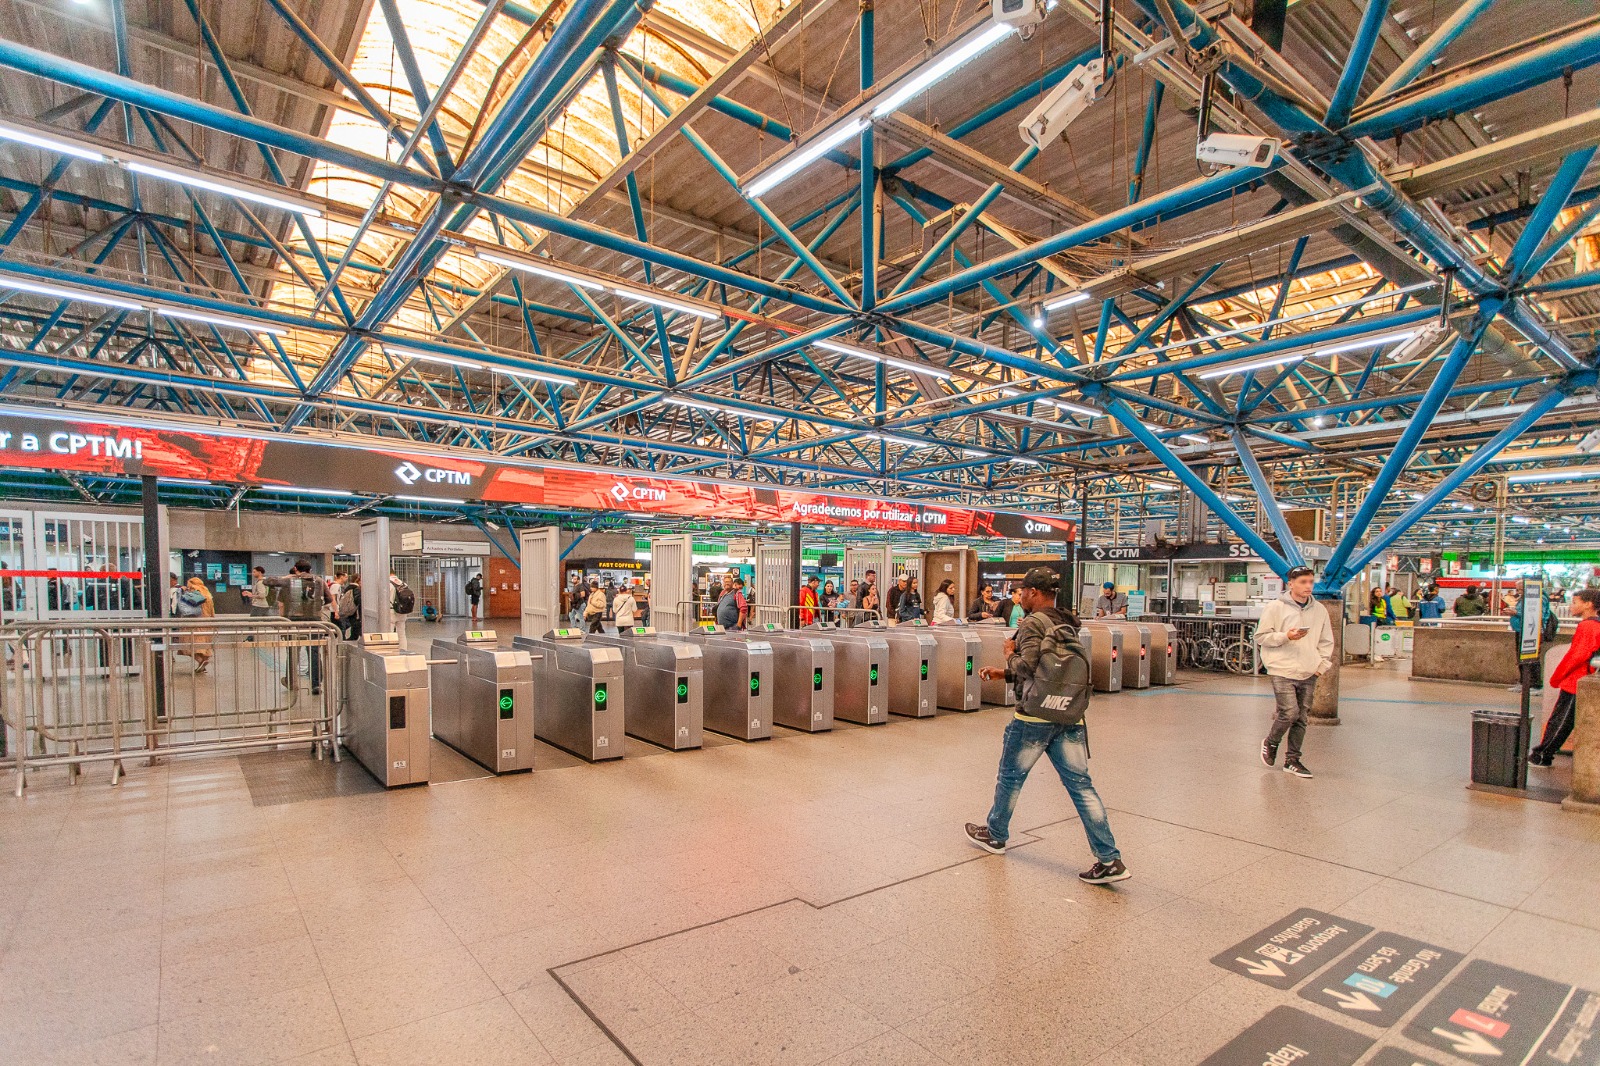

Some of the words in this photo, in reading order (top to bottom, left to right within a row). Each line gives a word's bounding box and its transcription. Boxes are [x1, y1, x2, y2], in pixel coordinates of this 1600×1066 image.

[21, 433, 39, 451] a
[49, 431, 143, 460] CPTM!
[425, 468, 471, 485] CPTM
[632, 487, 666, 501] CPTM
[792, 501, 862, 518] Agradecemos
[863, 509, 880, 521] por
[882, 508, 914, 522] utilizar
[914, 514, 922, 523] a
[922, 512, 947, 525] CPTM
[1034, 523, 1052, 533] CPTM
[1108, 548, 1140, 558] CPTM
[1304, 546, 1320, 557] CPTM
[1040, 694, 1073, 711] NIKE
[1270, 917, 1321, 944] Guarulhos
[1297, 924, 1349, 954] Aeroporto
[1377, 946, 1401, 957] da
[1418, 948, 1442, 961] Rio
[1357, 953, 1393, 973] Serra
[1388, 957, 1430, 984] Grande
[1355, 978, 1386, 993] 10
[1465, 1014, 1495, 1031] 7
